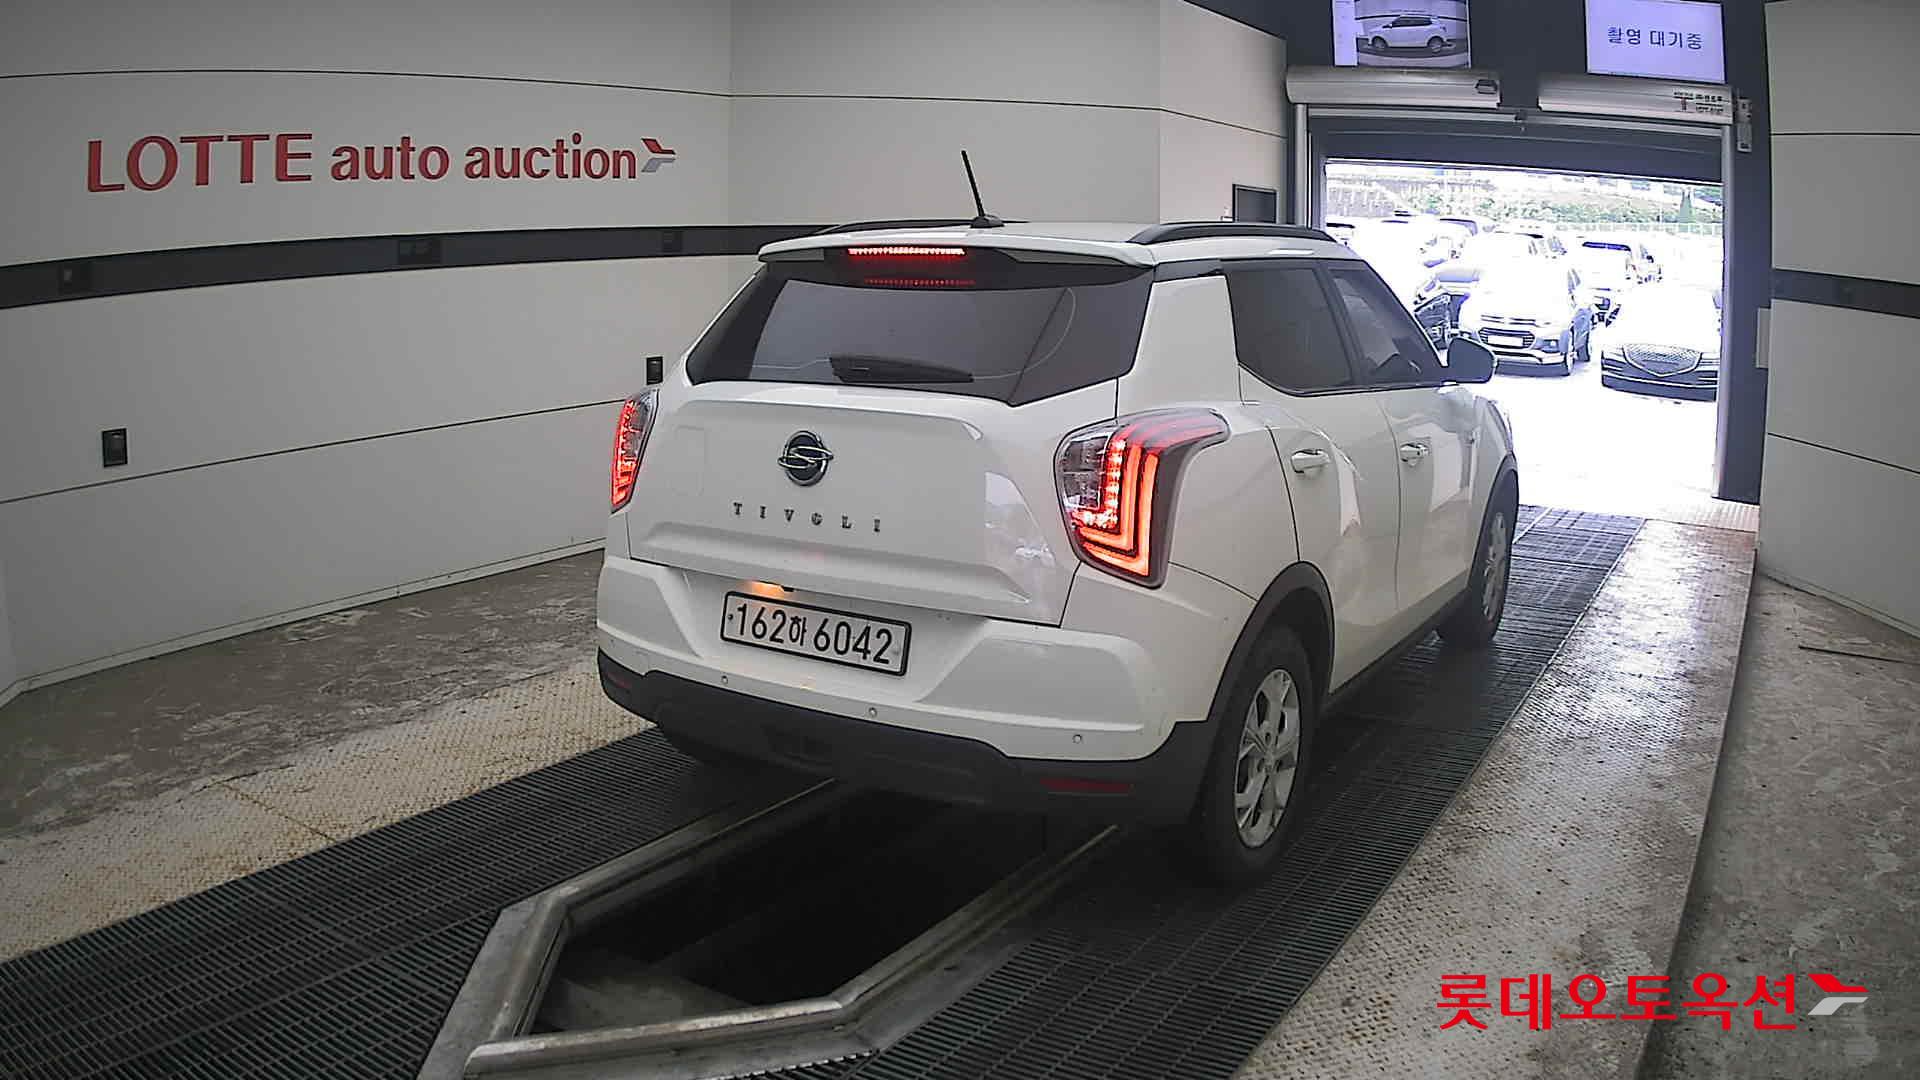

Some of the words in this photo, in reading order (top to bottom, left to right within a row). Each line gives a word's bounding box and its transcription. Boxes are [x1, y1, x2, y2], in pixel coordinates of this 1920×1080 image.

[1608, 27, 1641, 45] 촬영
[87, 133, 312, 192] LOTTE
[331, 136, 450, 180] auto
[464, 132, 637, 179] auction
[733, 502, 881, 532] TIVOLI
[737, 603, 807, 646] 162하
[813, 618, 892, 664] 6042
